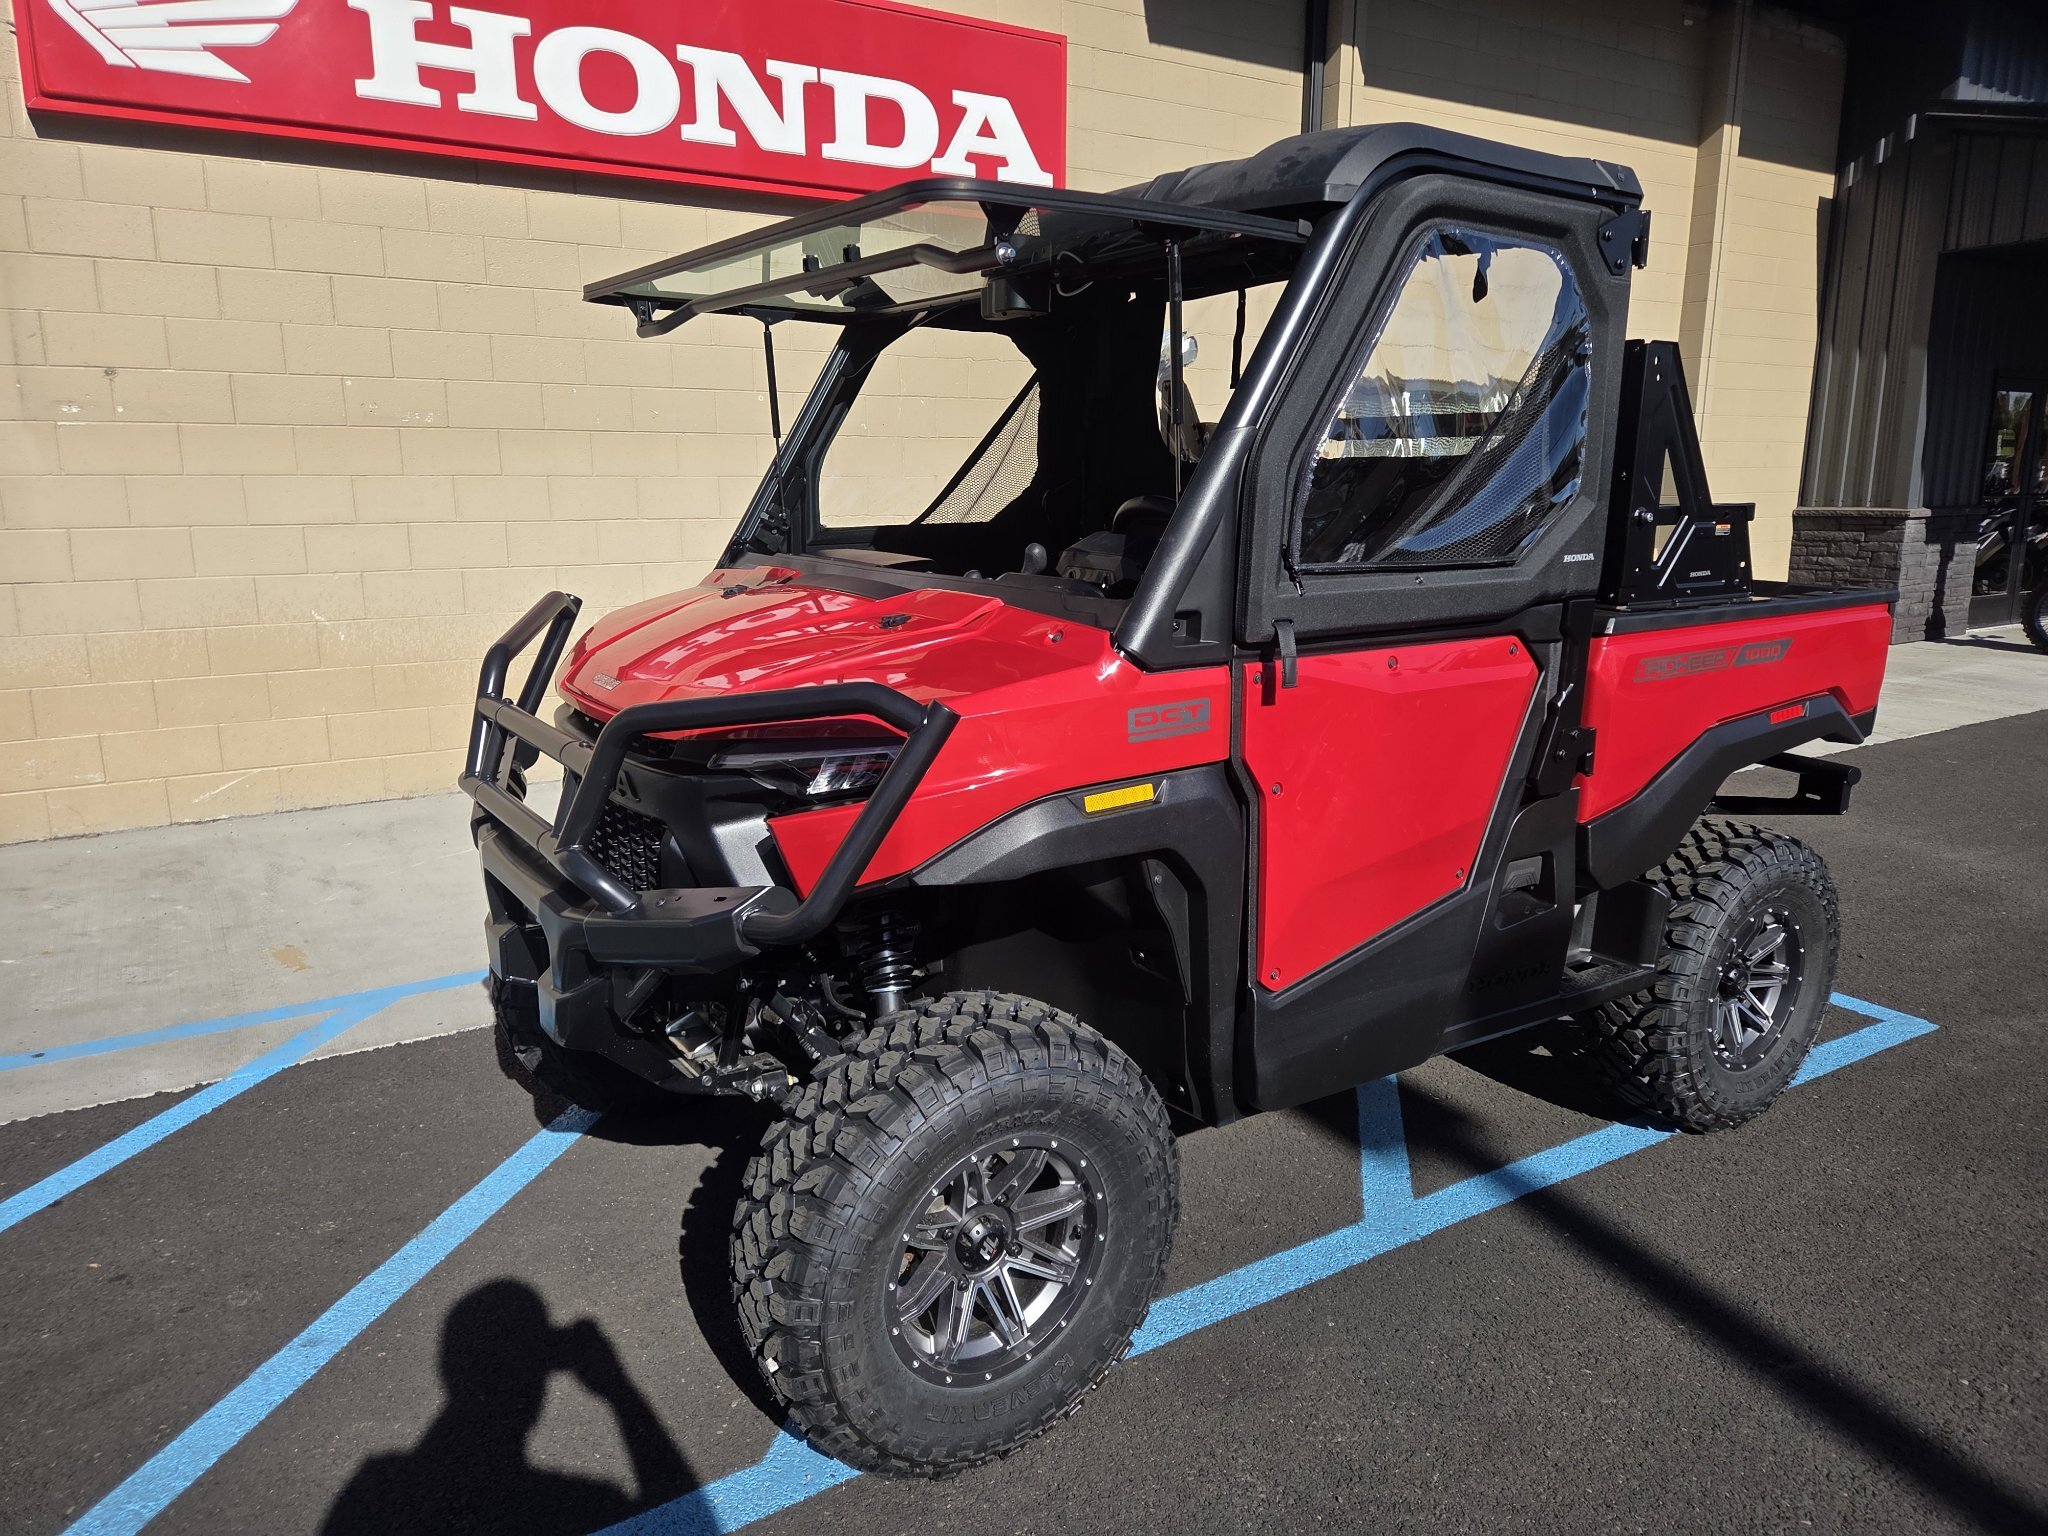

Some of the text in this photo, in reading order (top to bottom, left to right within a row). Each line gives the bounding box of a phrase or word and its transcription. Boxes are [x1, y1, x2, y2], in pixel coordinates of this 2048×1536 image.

[348, 0, 1054, 187] HONDA
[1563, 553, 1595, 563] HONDA
[1690, 570, 1711, 578] HONDA
[1644, 643, 1782, 674] PIONEER 1000
[1133, 703, 1205, 728] DCT
